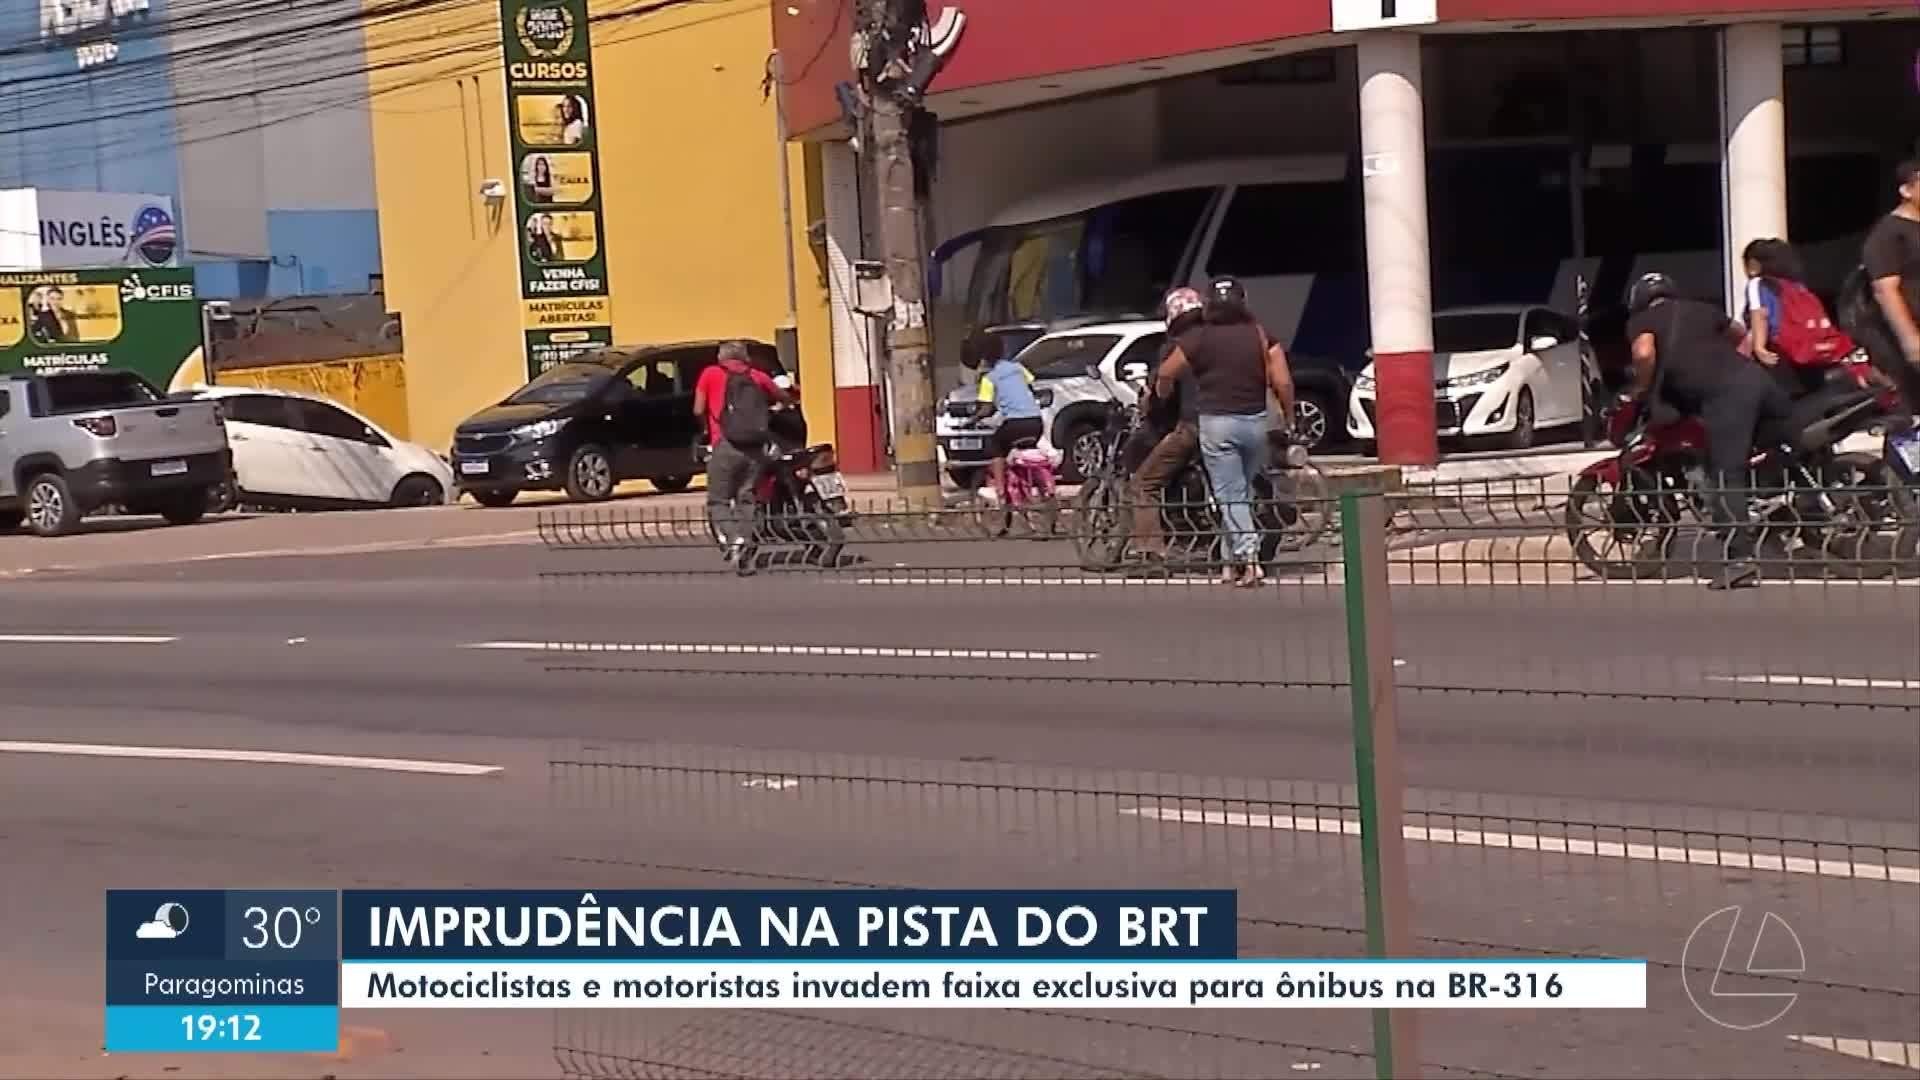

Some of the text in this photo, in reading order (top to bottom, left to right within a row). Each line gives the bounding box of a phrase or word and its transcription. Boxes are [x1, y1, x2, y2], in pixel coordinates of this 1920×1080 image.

[510, 62, 587, 79] CURSOS
[39, 216, 126, 248] INGLÊS
[542, 267, 586, 279] VENHA
[147, 284, 193, 297] CFIS
[529, 281, 568, 292] FAZER
[23, 352, 109, 368] MATRÍCULAS
